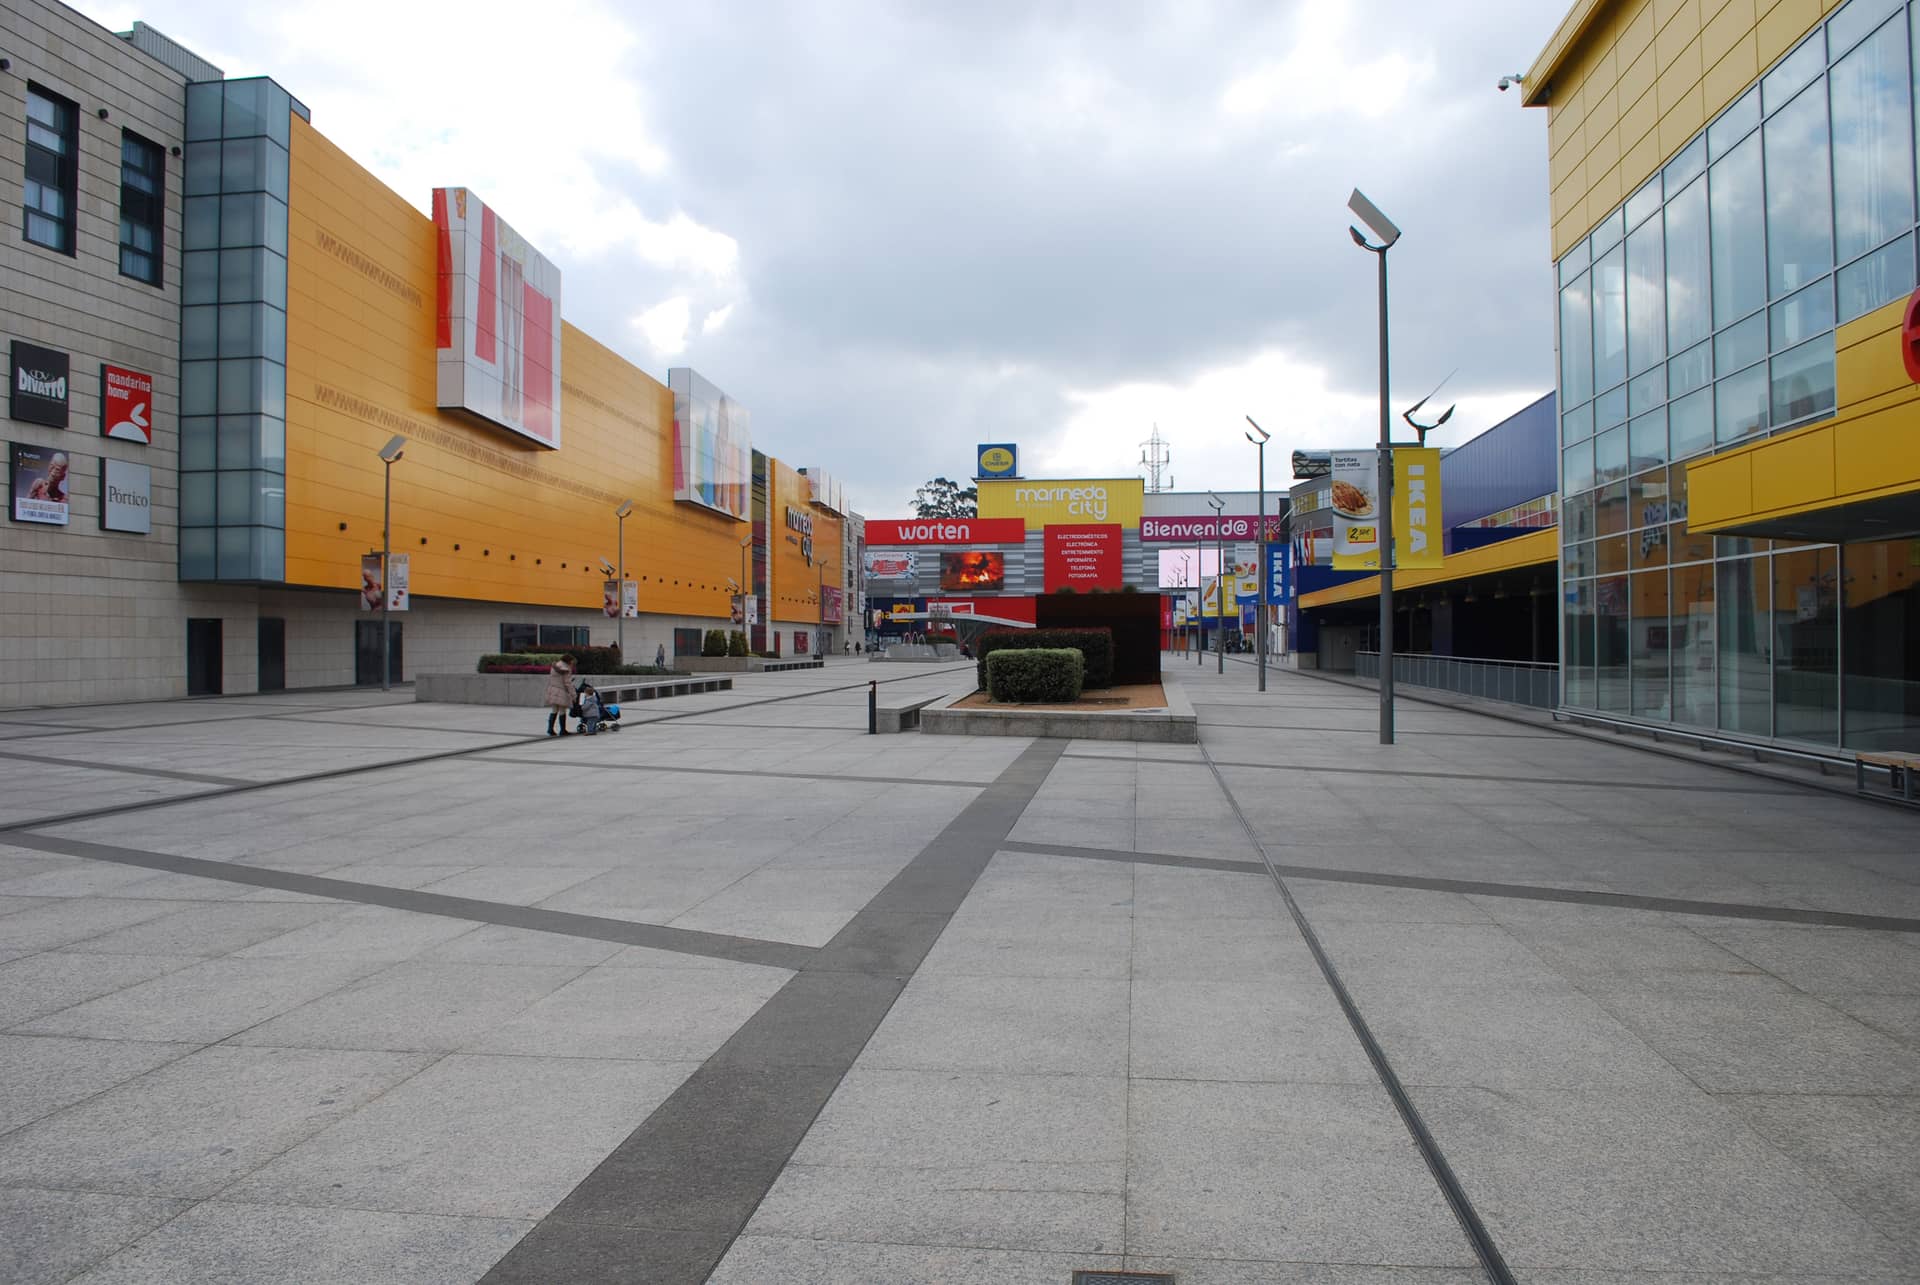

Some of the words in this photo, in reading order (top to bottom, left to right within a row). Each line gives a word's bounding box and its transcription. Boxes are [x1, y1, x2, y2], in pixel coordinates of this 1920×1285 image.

[107, 372, 151, 393] mandarina
[107, 384, 129, 400] home
[1015, 487, 1107, 502] marineda
[1068, 500, 1107, 521] city
[1408, 465, 1427, 555] IKEA
[898, 522, 970, 540] worten
[1143, 519, 1248, 537] Bienvenid@
[1273, 551, 1283, 597] IKEA
